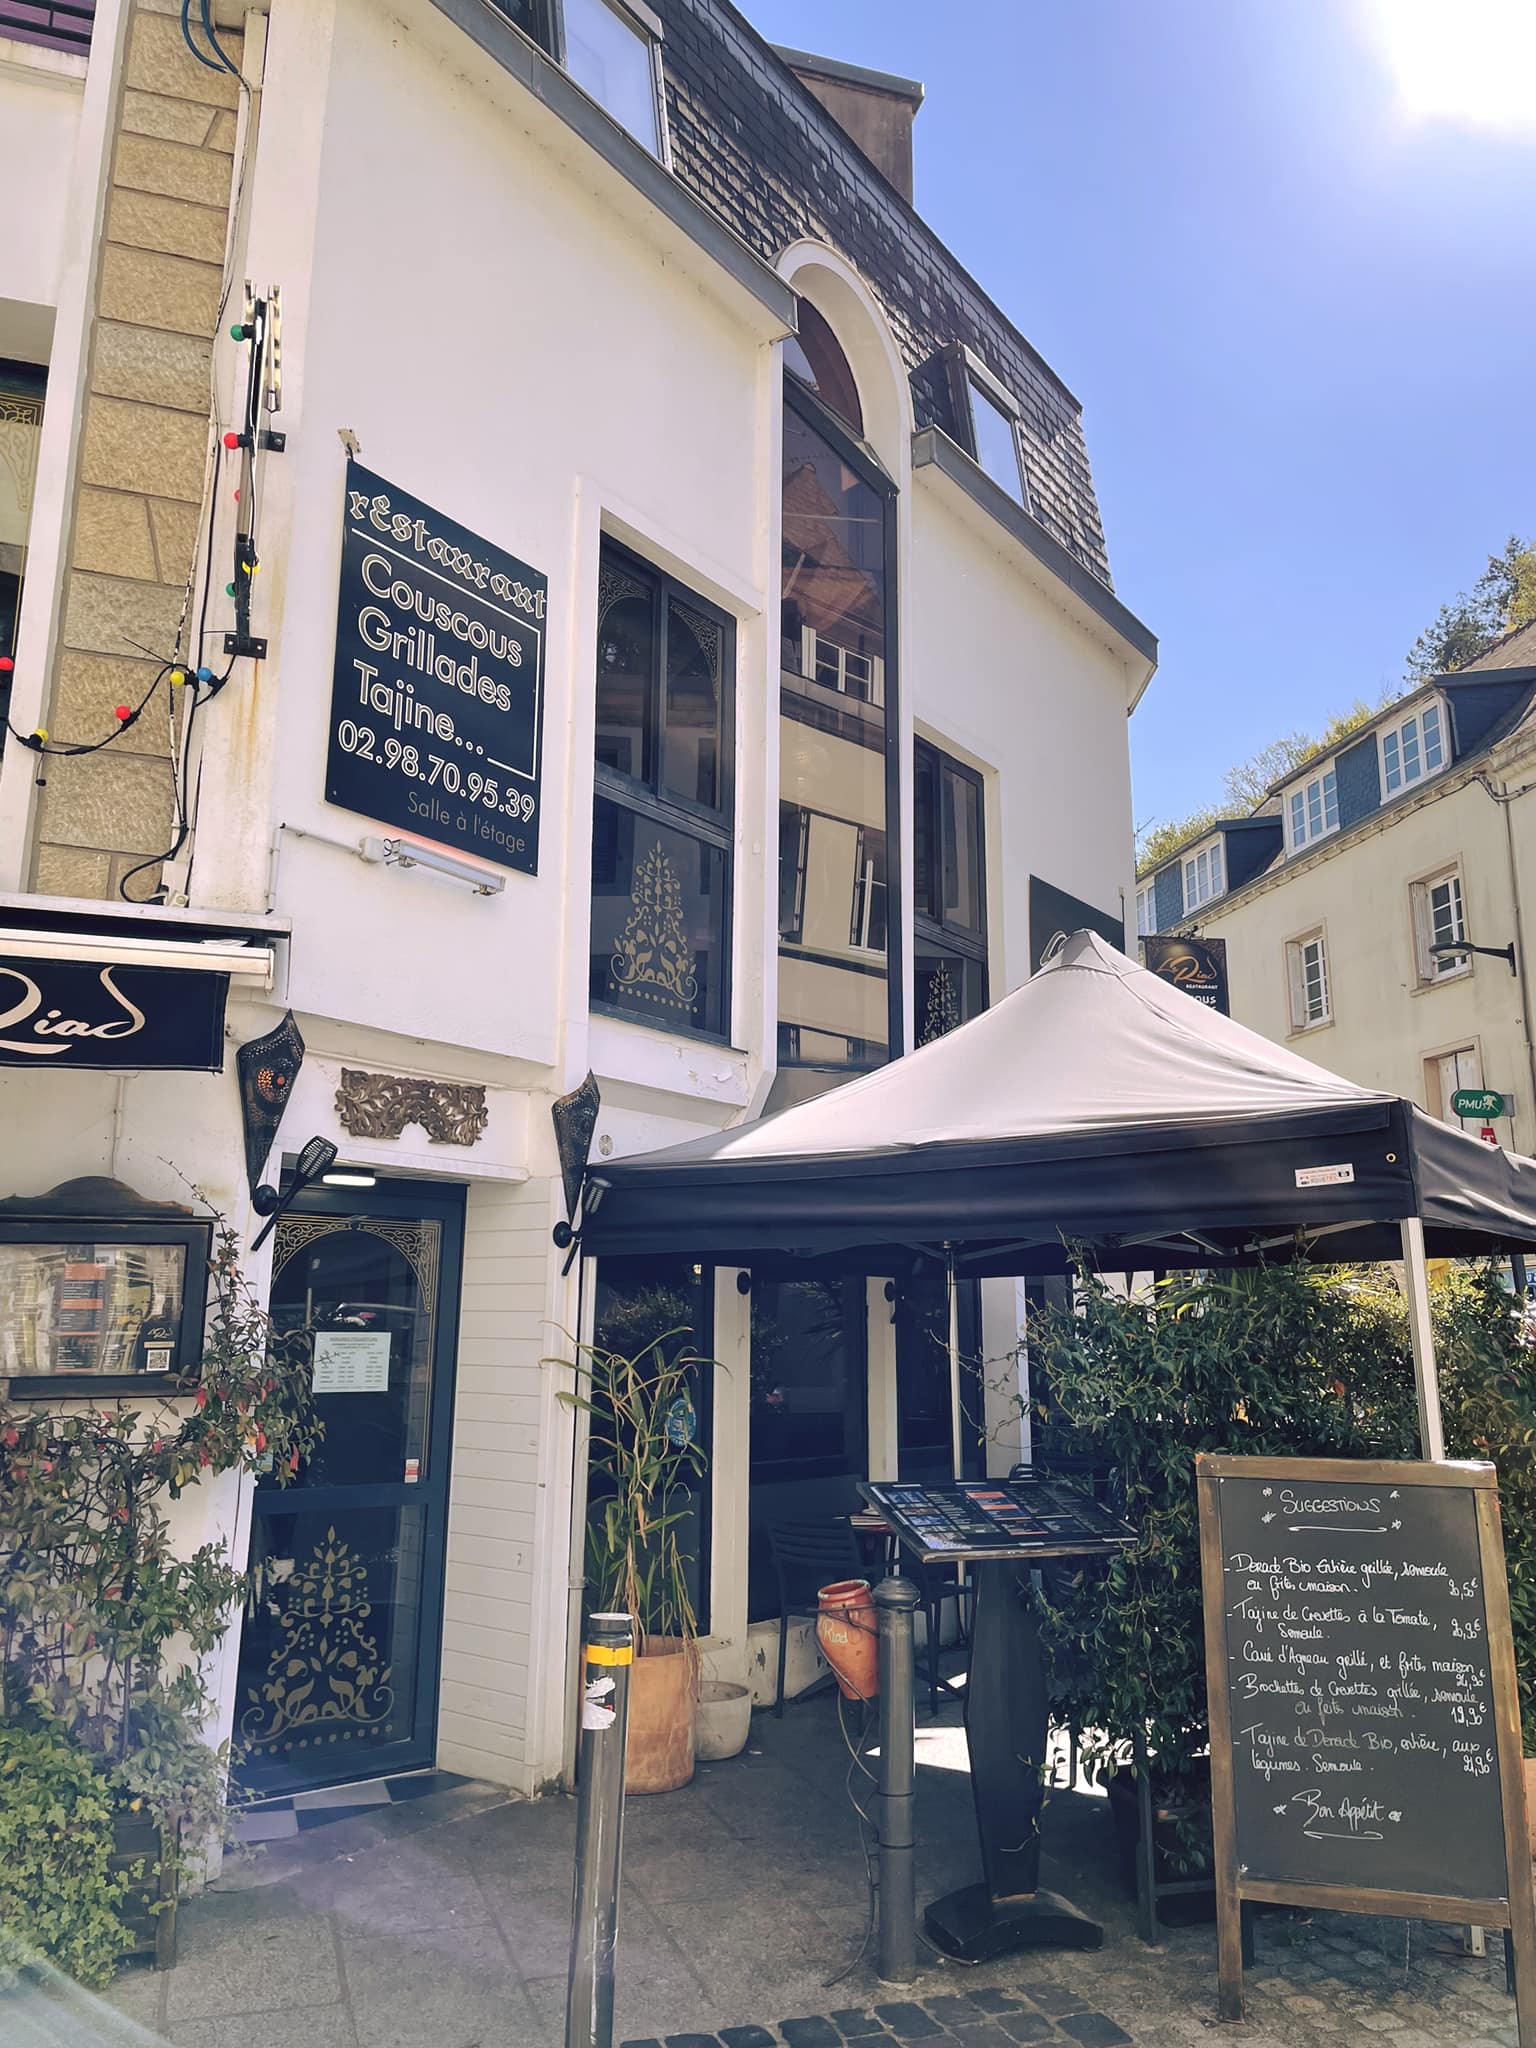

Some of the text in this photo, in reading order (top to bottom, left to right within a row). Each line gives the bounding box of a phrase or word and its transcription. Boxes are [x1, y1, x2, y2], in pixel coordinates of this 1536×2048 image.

[361, 553, 523, 668] Couscous
[358, 605, 511, 711] Grillades
[353, 659, 484, 756] Tajine...
[338, 720, 535, 823] 02.98.70.95.39
[408, 791, 526, 853] Salle à l'étage
[1458, 1098, 1482, 1109] PMU
[1282, 1557, 1312, 1574] Bio
[1246, 1579, 1263, 1592] ou
[1233, 1596, 1280, 1633] Tajine
[1282, 1603, 1299, 1620] de
[1357, 1609, 1368, 1623] à
[1372, 1605, 1386, 1623] la
[1278, 1644, 1329, 1676] d'Agneau
[1379, 1654, 1392, 1670] et
[1431, 1658, 1475, 1674] maison
[1238, 1673, 1305, 1699] Brochettes
[1309, 1679, 1324, 1697] de
[1295, 1700, 1312, 1715] ou
[1240, 1722, 1290, 1759] Tajine
[1293, 1725, 1309, 1748] de
[1451, 1739, 1481, 1754] aux
[1291, 1788, 1386, 1832] Bon Appétit
